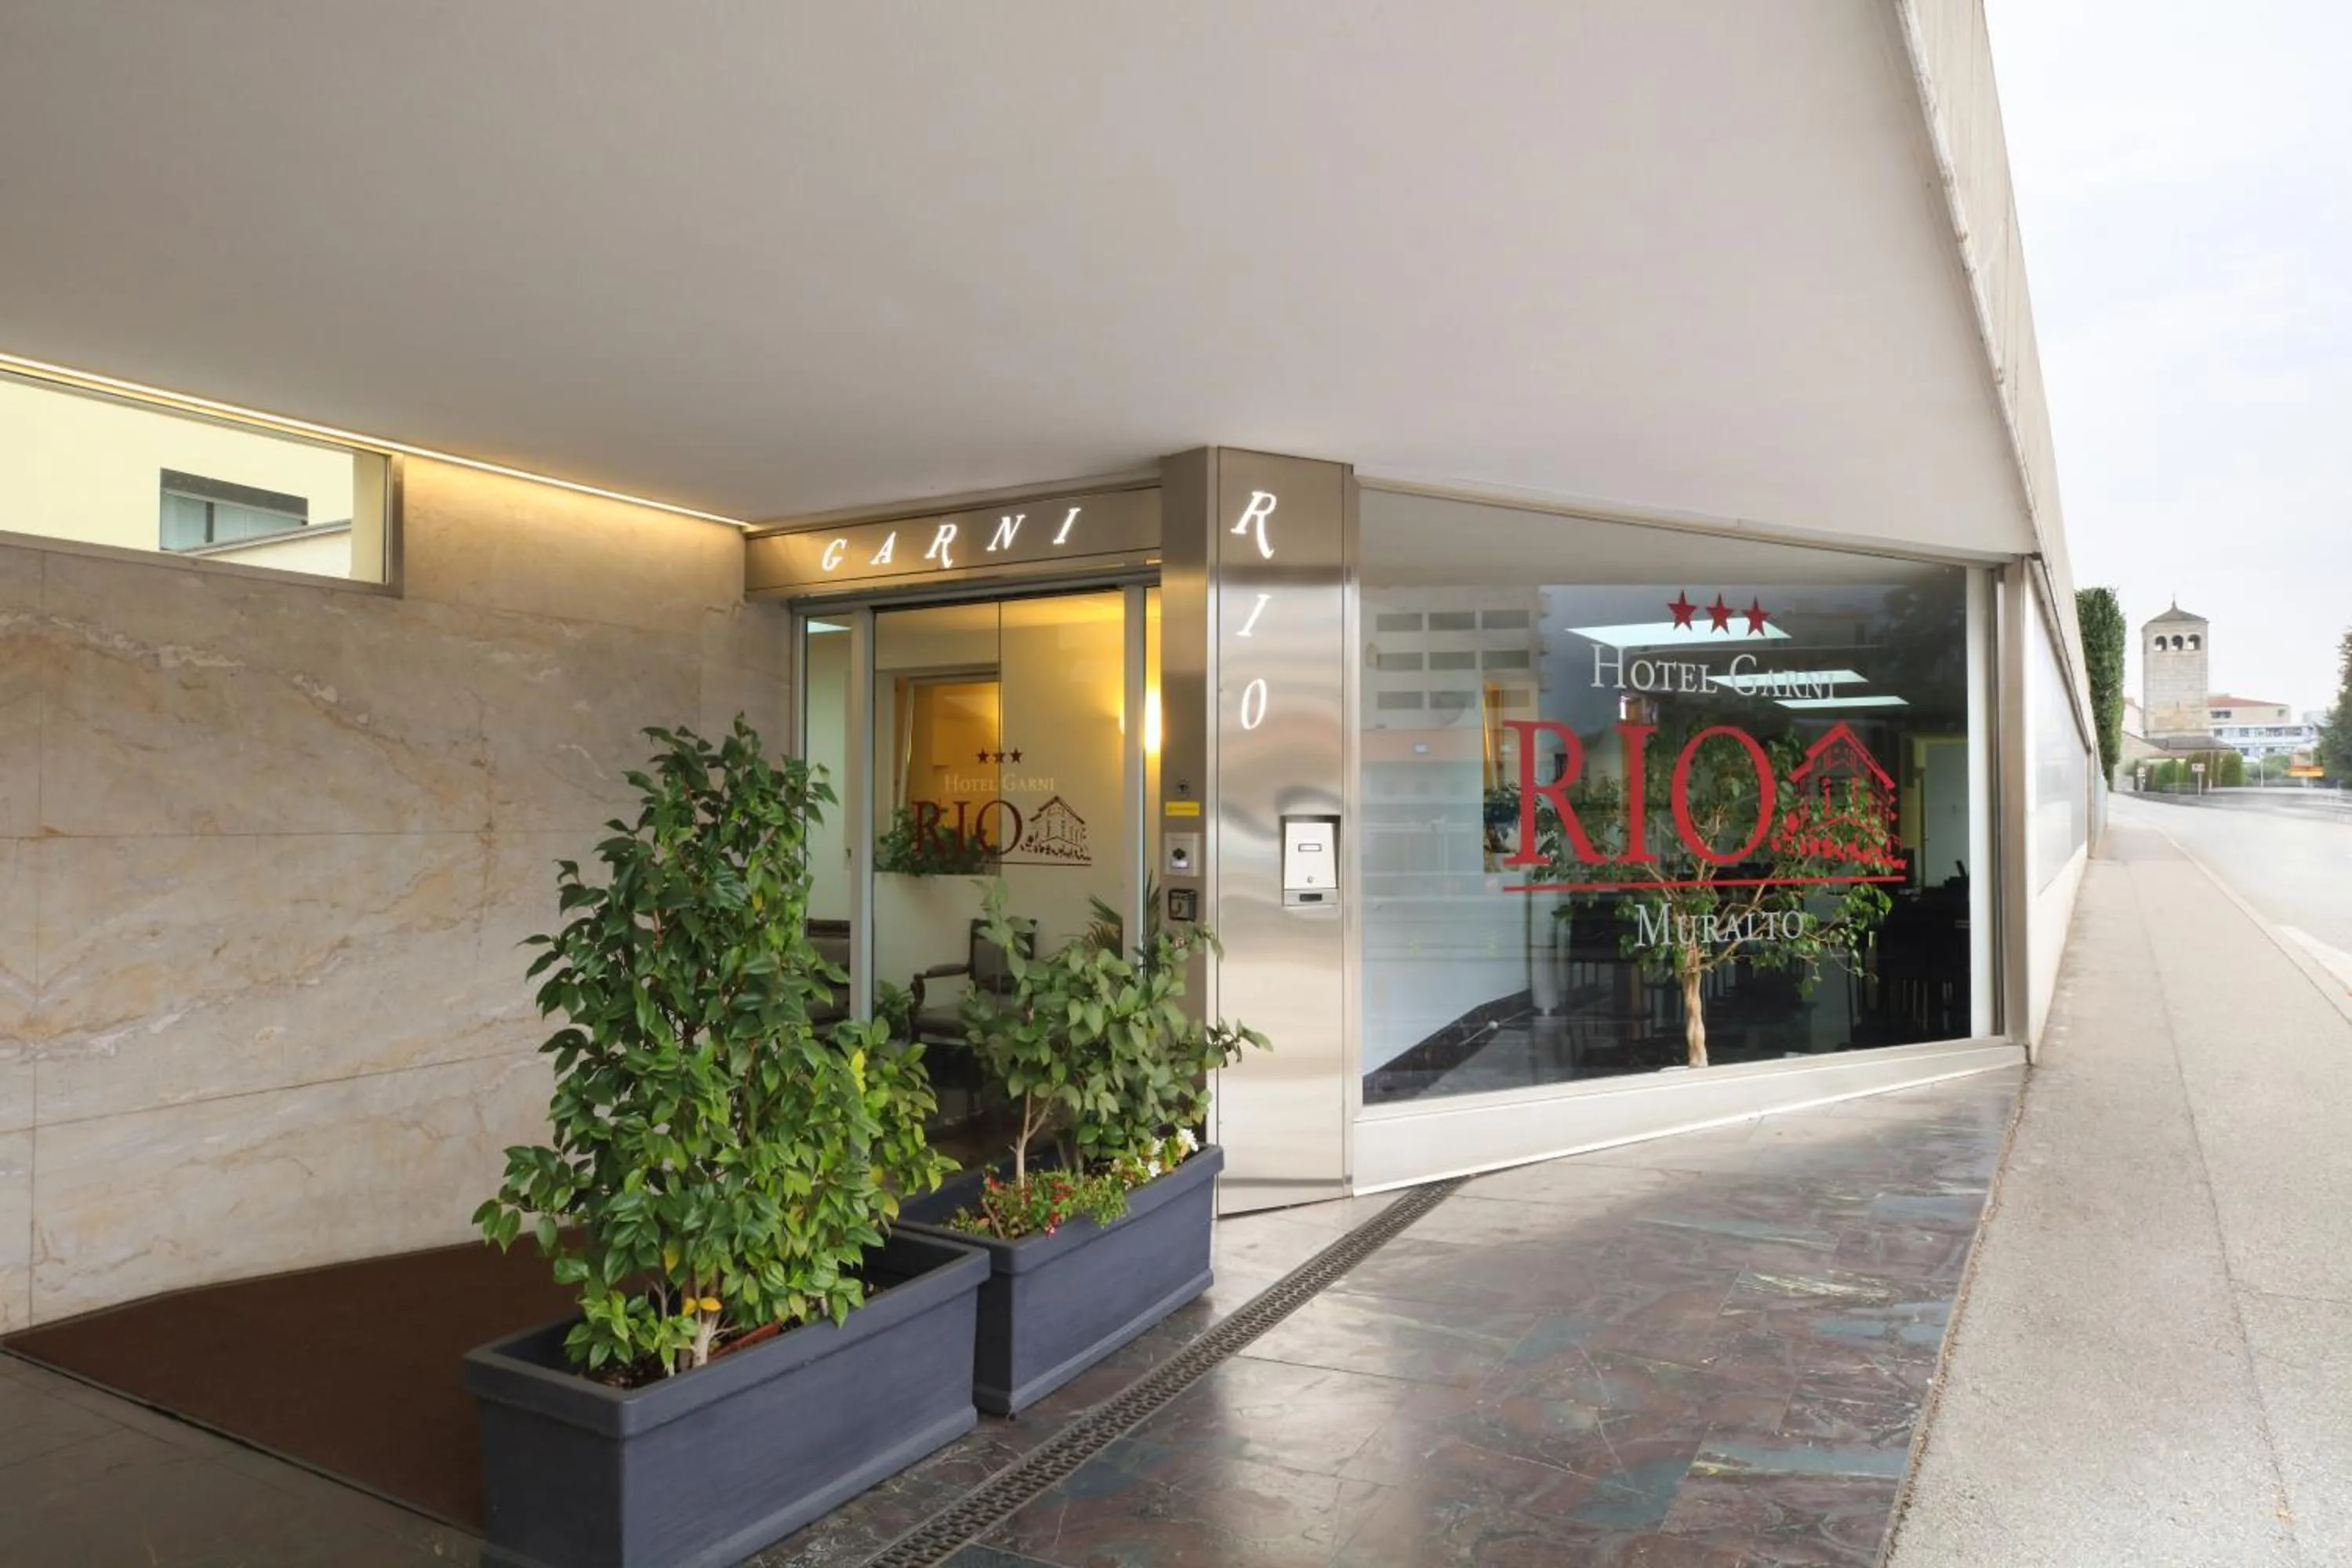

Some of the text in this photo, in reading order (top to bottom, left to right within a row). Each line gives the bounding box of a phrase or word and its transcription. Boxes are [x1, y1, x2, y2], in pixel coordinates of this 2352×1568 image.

[822, 508, 1081, 569] GARNI
[1231, 491, 1277, 731] RIO
[1591, 644, 1719, 694] HOTEL
[1503, 720, 1777, 866] RIO
[913, 800, 1022, 856] RIO
[1635, 904, 1804, 947] MURALTO
